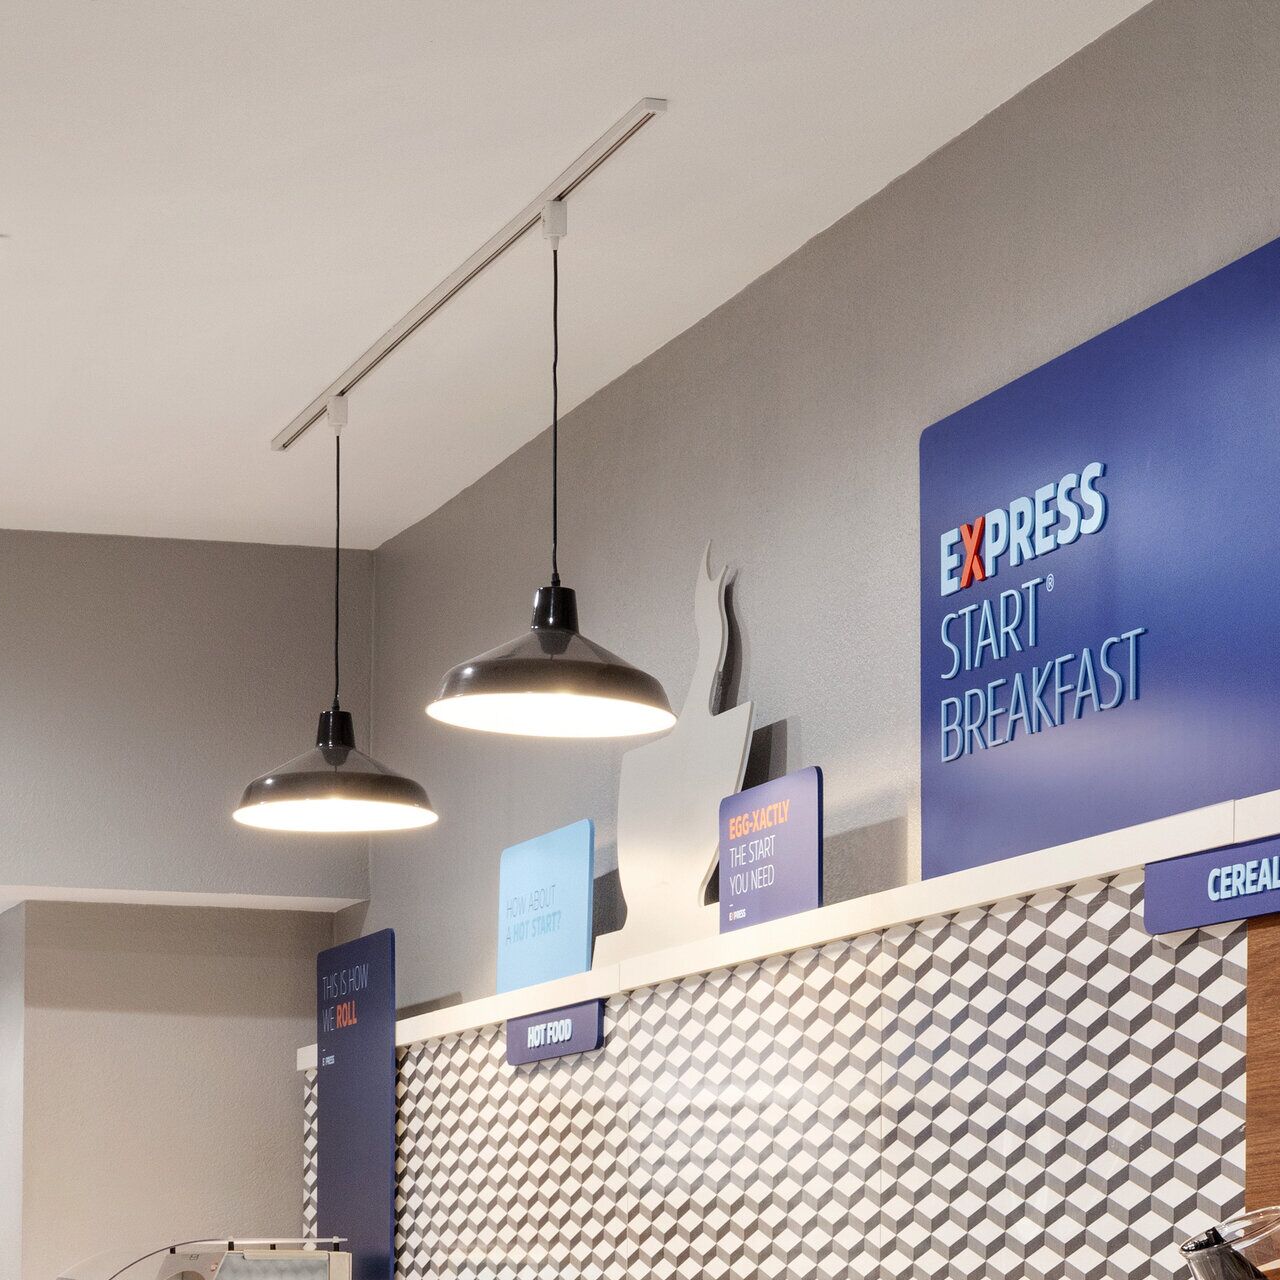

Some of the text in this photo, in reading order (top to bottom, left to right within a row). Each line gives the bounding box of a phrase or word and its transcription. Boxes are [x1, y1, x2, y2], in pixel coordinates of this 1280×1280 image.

[940, 462, 1106, 597] EXPRESS
[940, 627, 1148, 763] BREAKFAST
[728, 799, 791, 840] EGG-XACTLY
[729, 835, 776, 868] THE START
[729, 864, 775, 897] YOU NEED
[506, 884, 557, 919] HOW ABOUT
[506, 910, 562, 944] A HOT START?
[322, 963, 369, 1000] THIS IS HOW
[322, 1000, 358, 1032] WE ROLL
[527, 1018, 573, 1049] HOT FOOD
